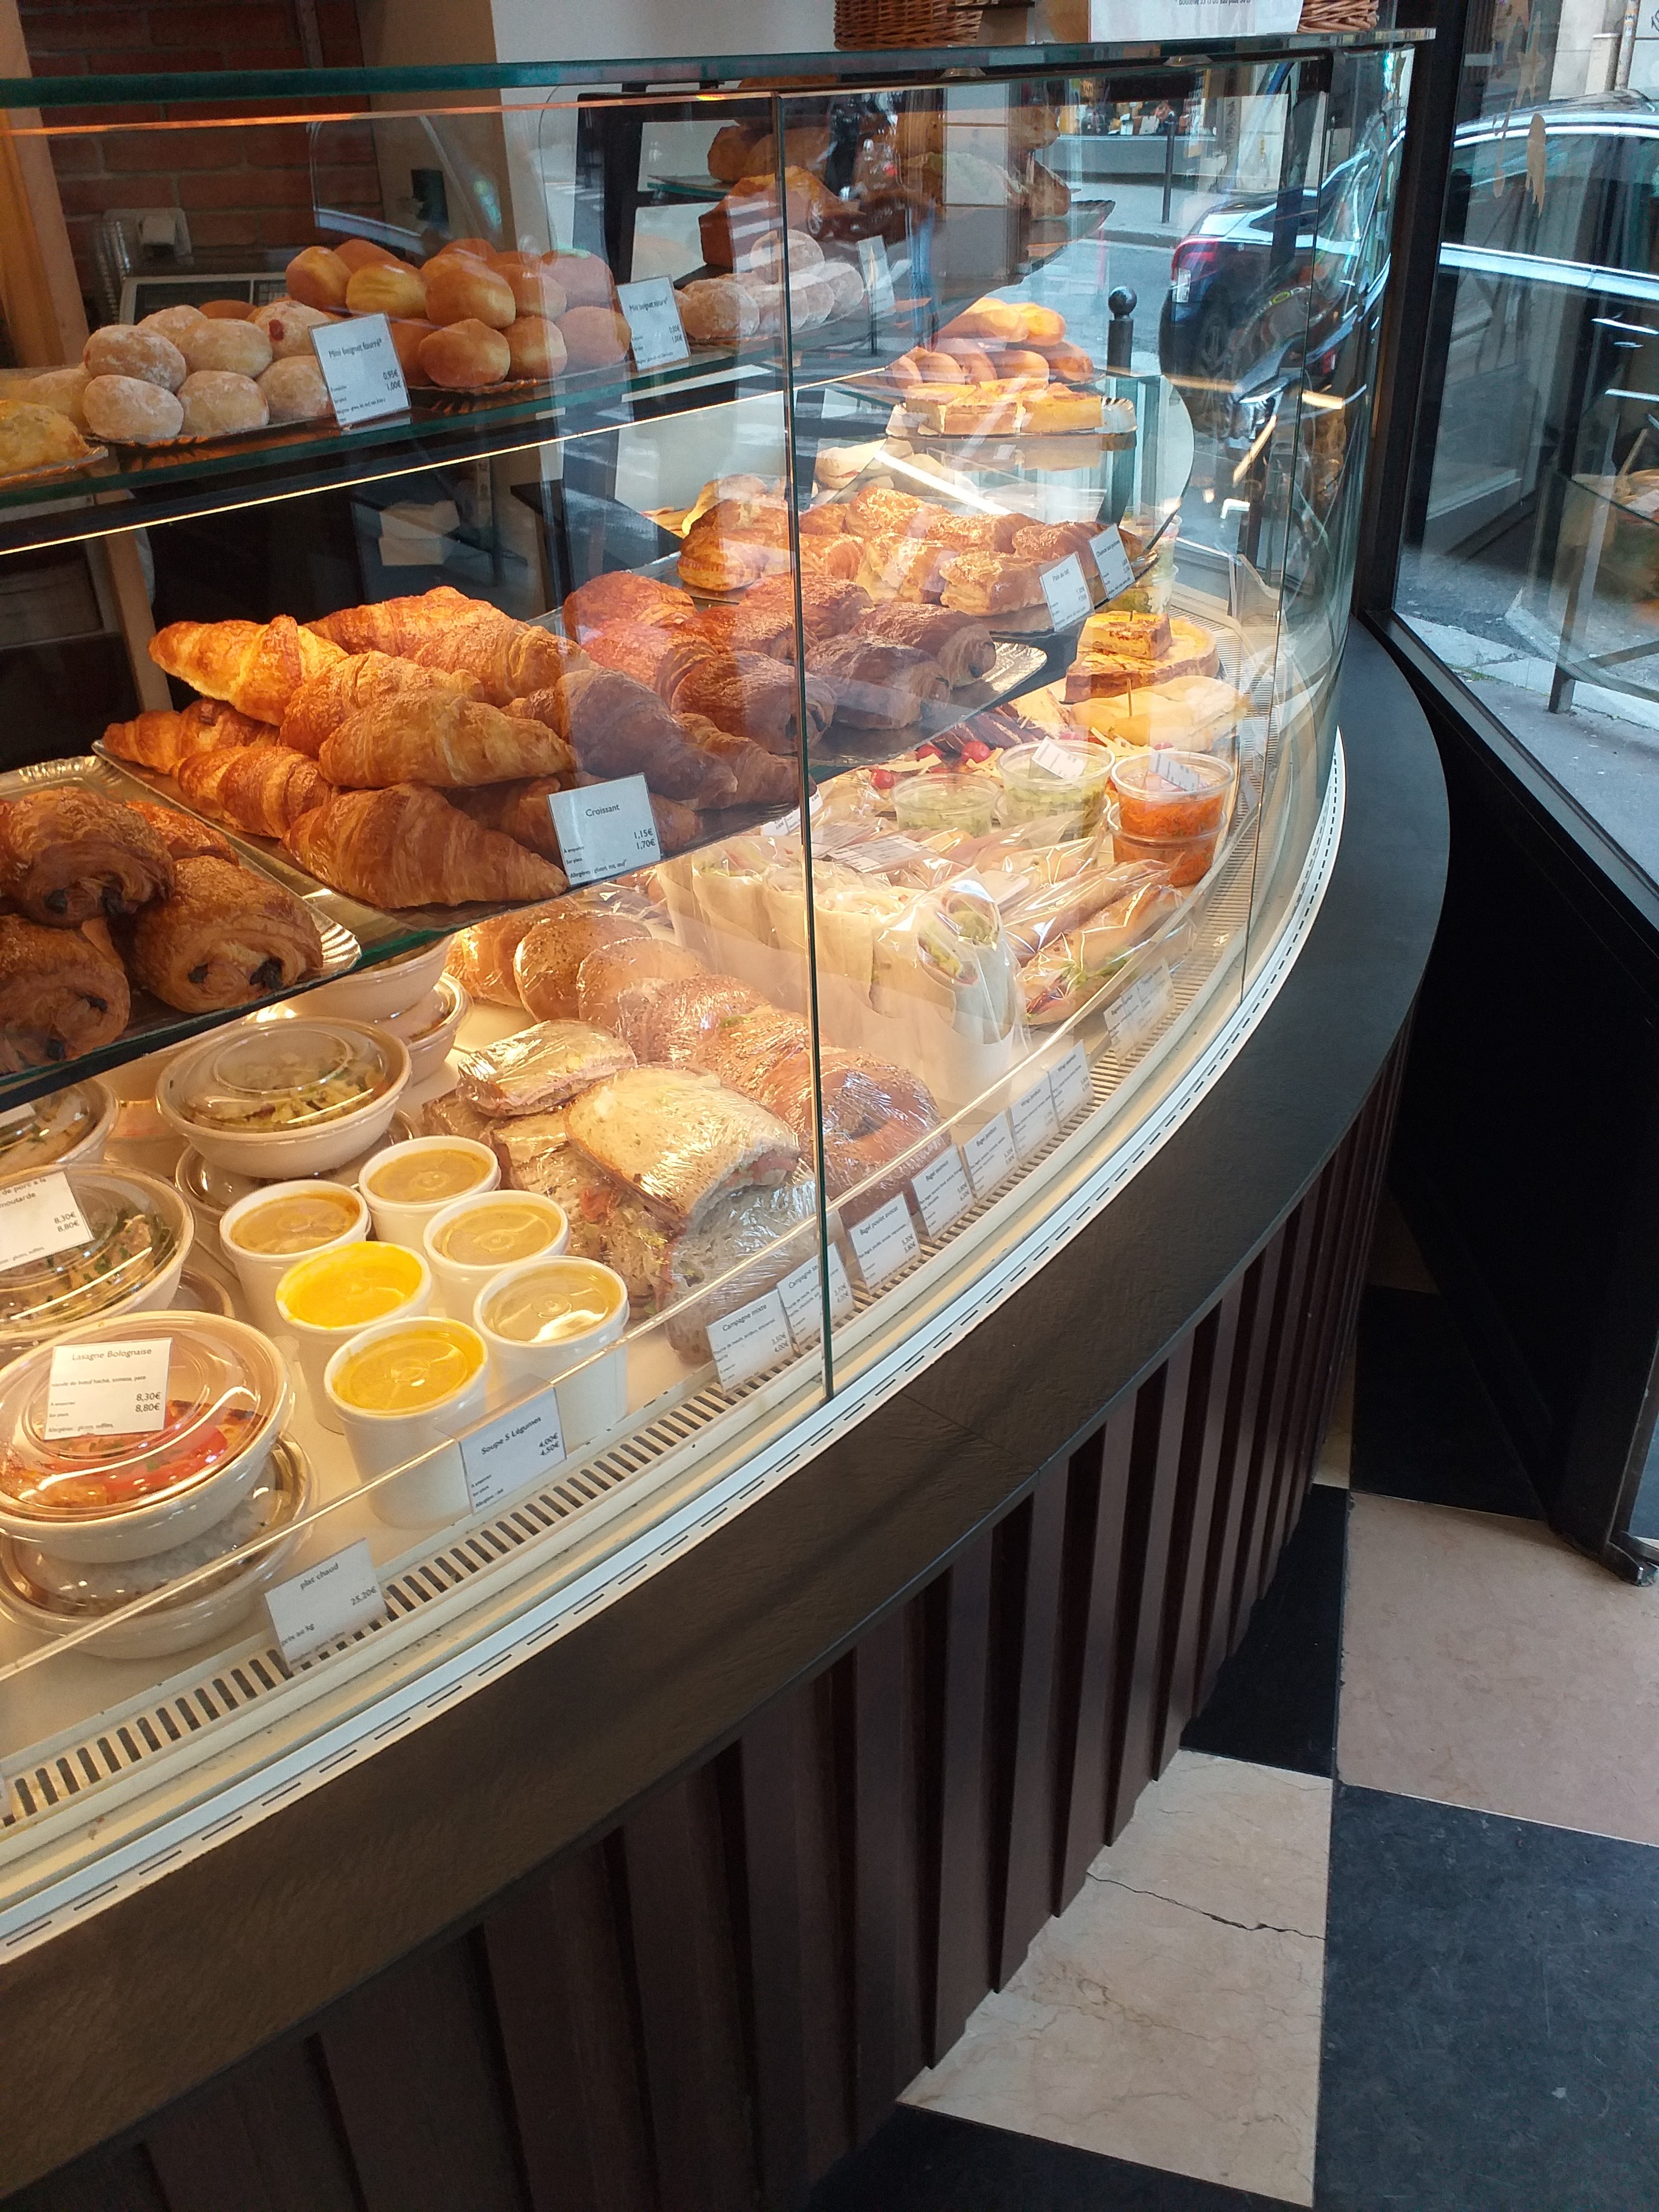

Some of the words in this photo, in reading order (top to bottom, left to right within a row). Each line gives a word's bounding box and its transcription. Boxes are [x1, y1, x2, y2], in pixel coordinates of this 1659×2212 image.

[383, 369, 399, 380] 0,95€
[386, 379, 402, 392] 1,00€
[585, 804, 620, 817] Croissant
[634, 828, 653, 839] 1,15€
[636, 838, 656, 850] 1,70€
[14, 1182, 32, 1193] porc
[54, 1210, 77, 1224] 8,30€
[57, 1220, 80, 1232] 8,80€
[722, 1313, 751, 1332] Campagne
[751, 1303, 767, 1315] mixte
[72, 1352, 104, 1361] Lasagne
[107, 1349, 152, 1360] Bolognaise
[136, 1392, 161, 1402] 8,30€
[135, 1403, 160, 1413] 8,80€
[481, 1439, 504, 1455] Soupe
[511, 1416, 541, 1437] Légumes
[540, 1441, 559, 1456] 4,50€
[316, 1561, 339, 1580] chaud
[350, 1585, 377, 1606] 25,20€
[305, 1623, 315, 1632] kg
